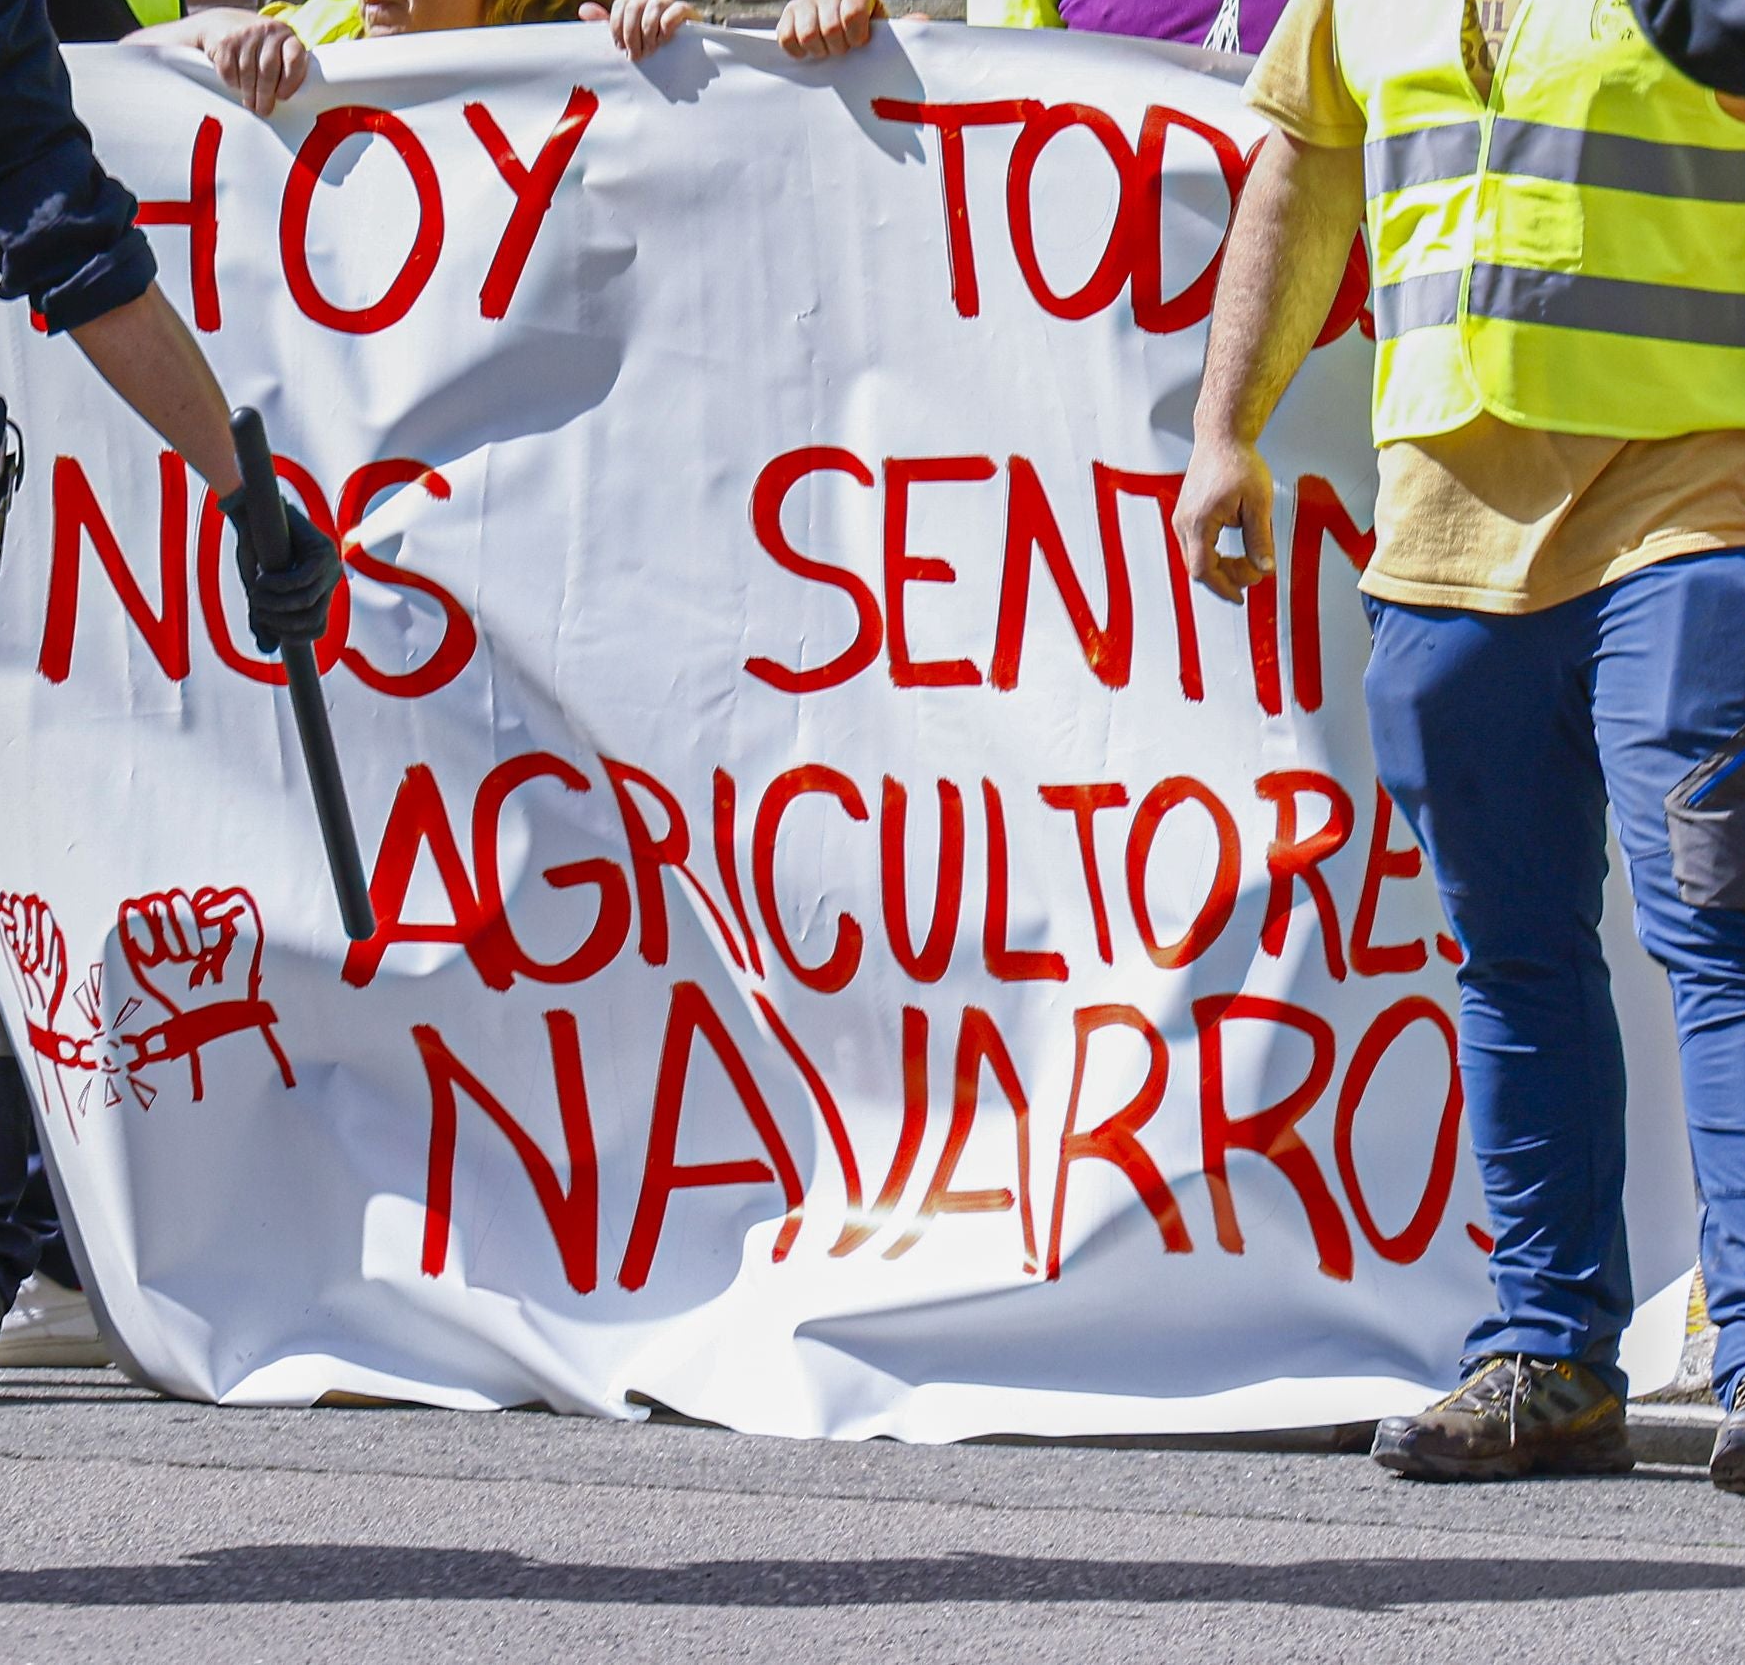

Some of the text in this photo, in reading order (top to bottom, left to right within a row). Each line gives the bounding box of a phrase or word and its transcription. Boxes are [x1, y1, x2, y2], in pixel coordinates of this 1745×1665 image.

[30, 85, 1375, 348] HOY TOD
[36, 447, 478, 698] NOS
[340, 751, 1465, 995] AGRICULTORE
[411, 980, 1494, 1295] NAVARRO
